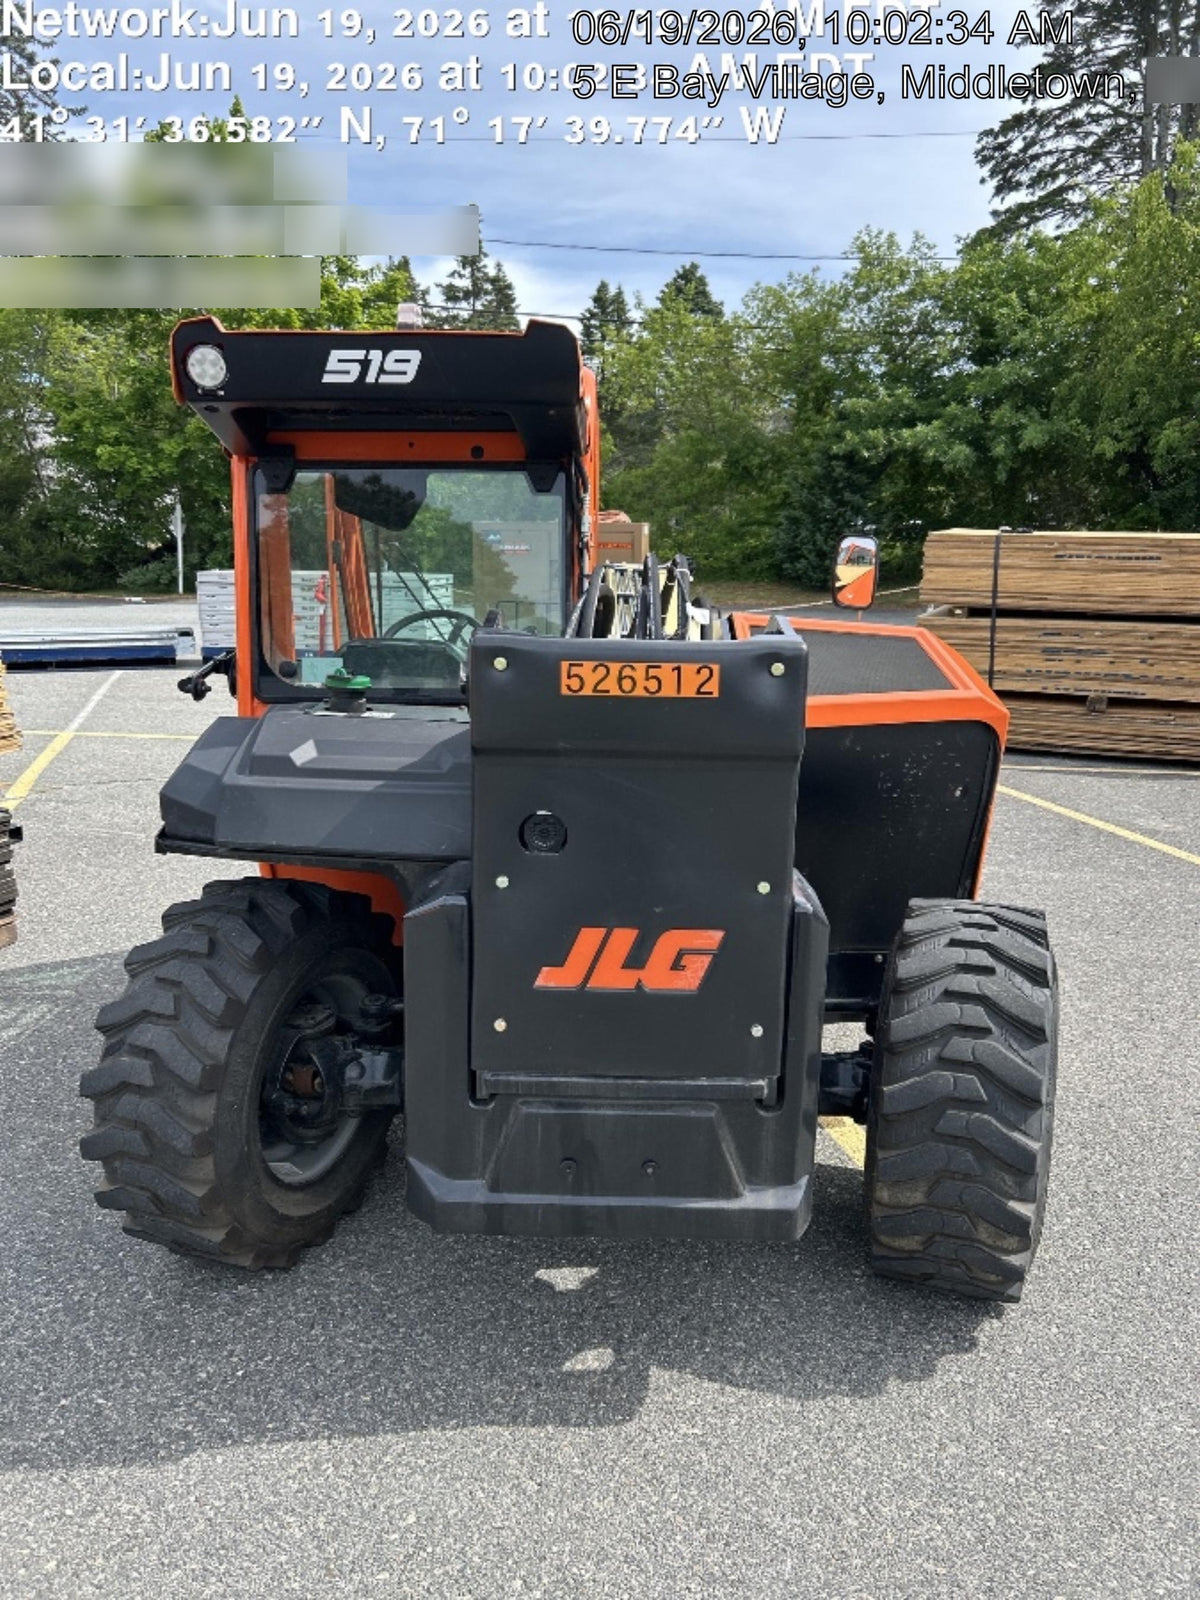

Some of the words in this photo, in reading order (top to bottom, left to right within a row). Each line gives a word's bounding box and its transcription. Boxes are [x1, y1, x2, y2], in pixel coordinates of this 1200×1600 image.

[321, 349, 422, 384] 519
[565, 662, 715, 696] 526512
[533, 927, 726, 993] JLG
